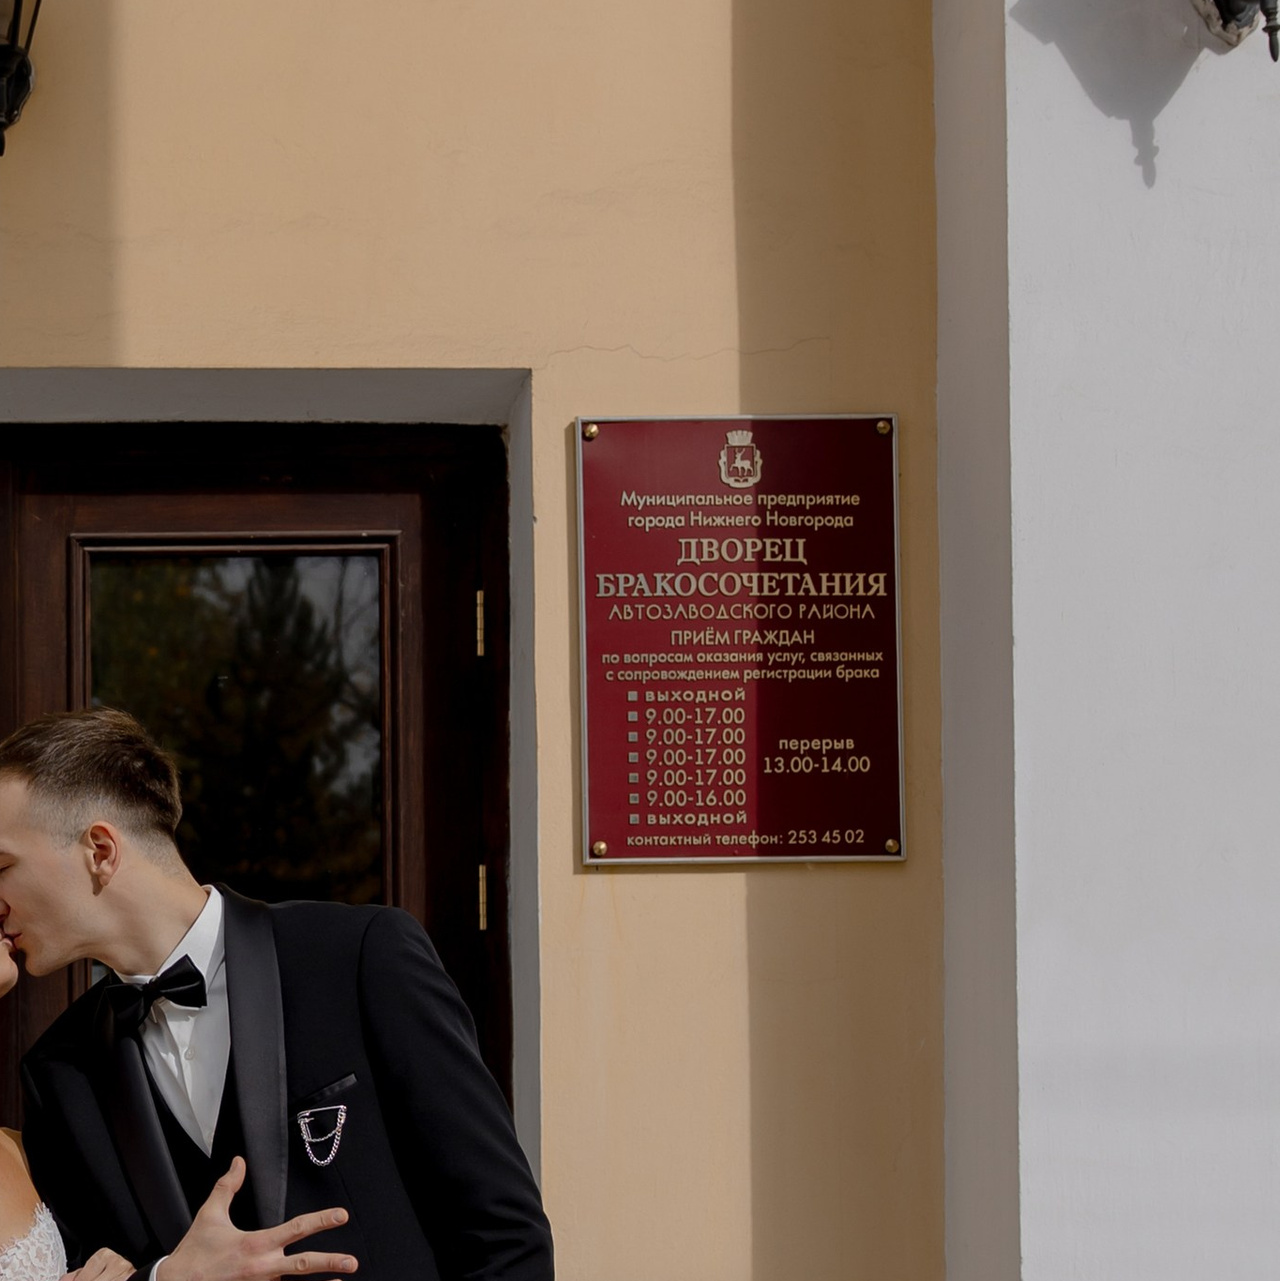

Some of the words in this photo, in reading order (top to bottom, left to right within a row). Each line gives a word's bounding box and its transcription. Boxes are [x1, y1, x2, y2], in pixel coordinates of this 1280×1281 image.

[620, 490, 754, 511] Муниципальное
[757, 492, 861, 510] предприятие
[627, 514, 686, 533] города
[689, 510, 762, 530] Нижнего
[765, 511, 854, 531] Новгорода
[676, 537, 808, 567] ДВОРЕЦ
[595, 571, 888, 599] БРАКОСОЧЕТАНИЯ
[607, 602, 792, 622] АВТОЗАВОДСКОГО
[798, 602, 876, 620] РАЙОНА
[670, 625, 731, 647] ПРИЁМ
[733, 629, 815, 647] ГРАЖДАН
[601, 652, 620, 665] по
[622, 651, 694, 667] вопросам
[696, 650, 764, 664] оказания
[766, 651, 807, 666] услуг,
[809, 650, 884, 663] связанных
[605, 670, 615, 682] с
[617, 669, 740, 684] сопровождением
[742, 668, 833, 683] регистрации
[835, 664, 880, 680] брака
[645, 686, 746, 704] выходной
[644, 707, 746, 725] 9.00-17.00
[644, 727, 746, 746] 9.00-17.00
[778, 737, 855, 756] перерыв
[645, 748, 747, 766] 9.00-17.00
[762, 756, 872, 774] 13.00-14.00
[645, 768, 747, 787] 9.00-17.00
[646, 789, 747, 808] 9.00-16.00
[646, 810, 748, 827] выходной
[626, 833, 712, 847] контактный
[715, 831, 784, 849] телефон:
[787, 830, 817, 845] 253
[820, 829, 842, 845] 45
[844, 829, 865, 844] 02
